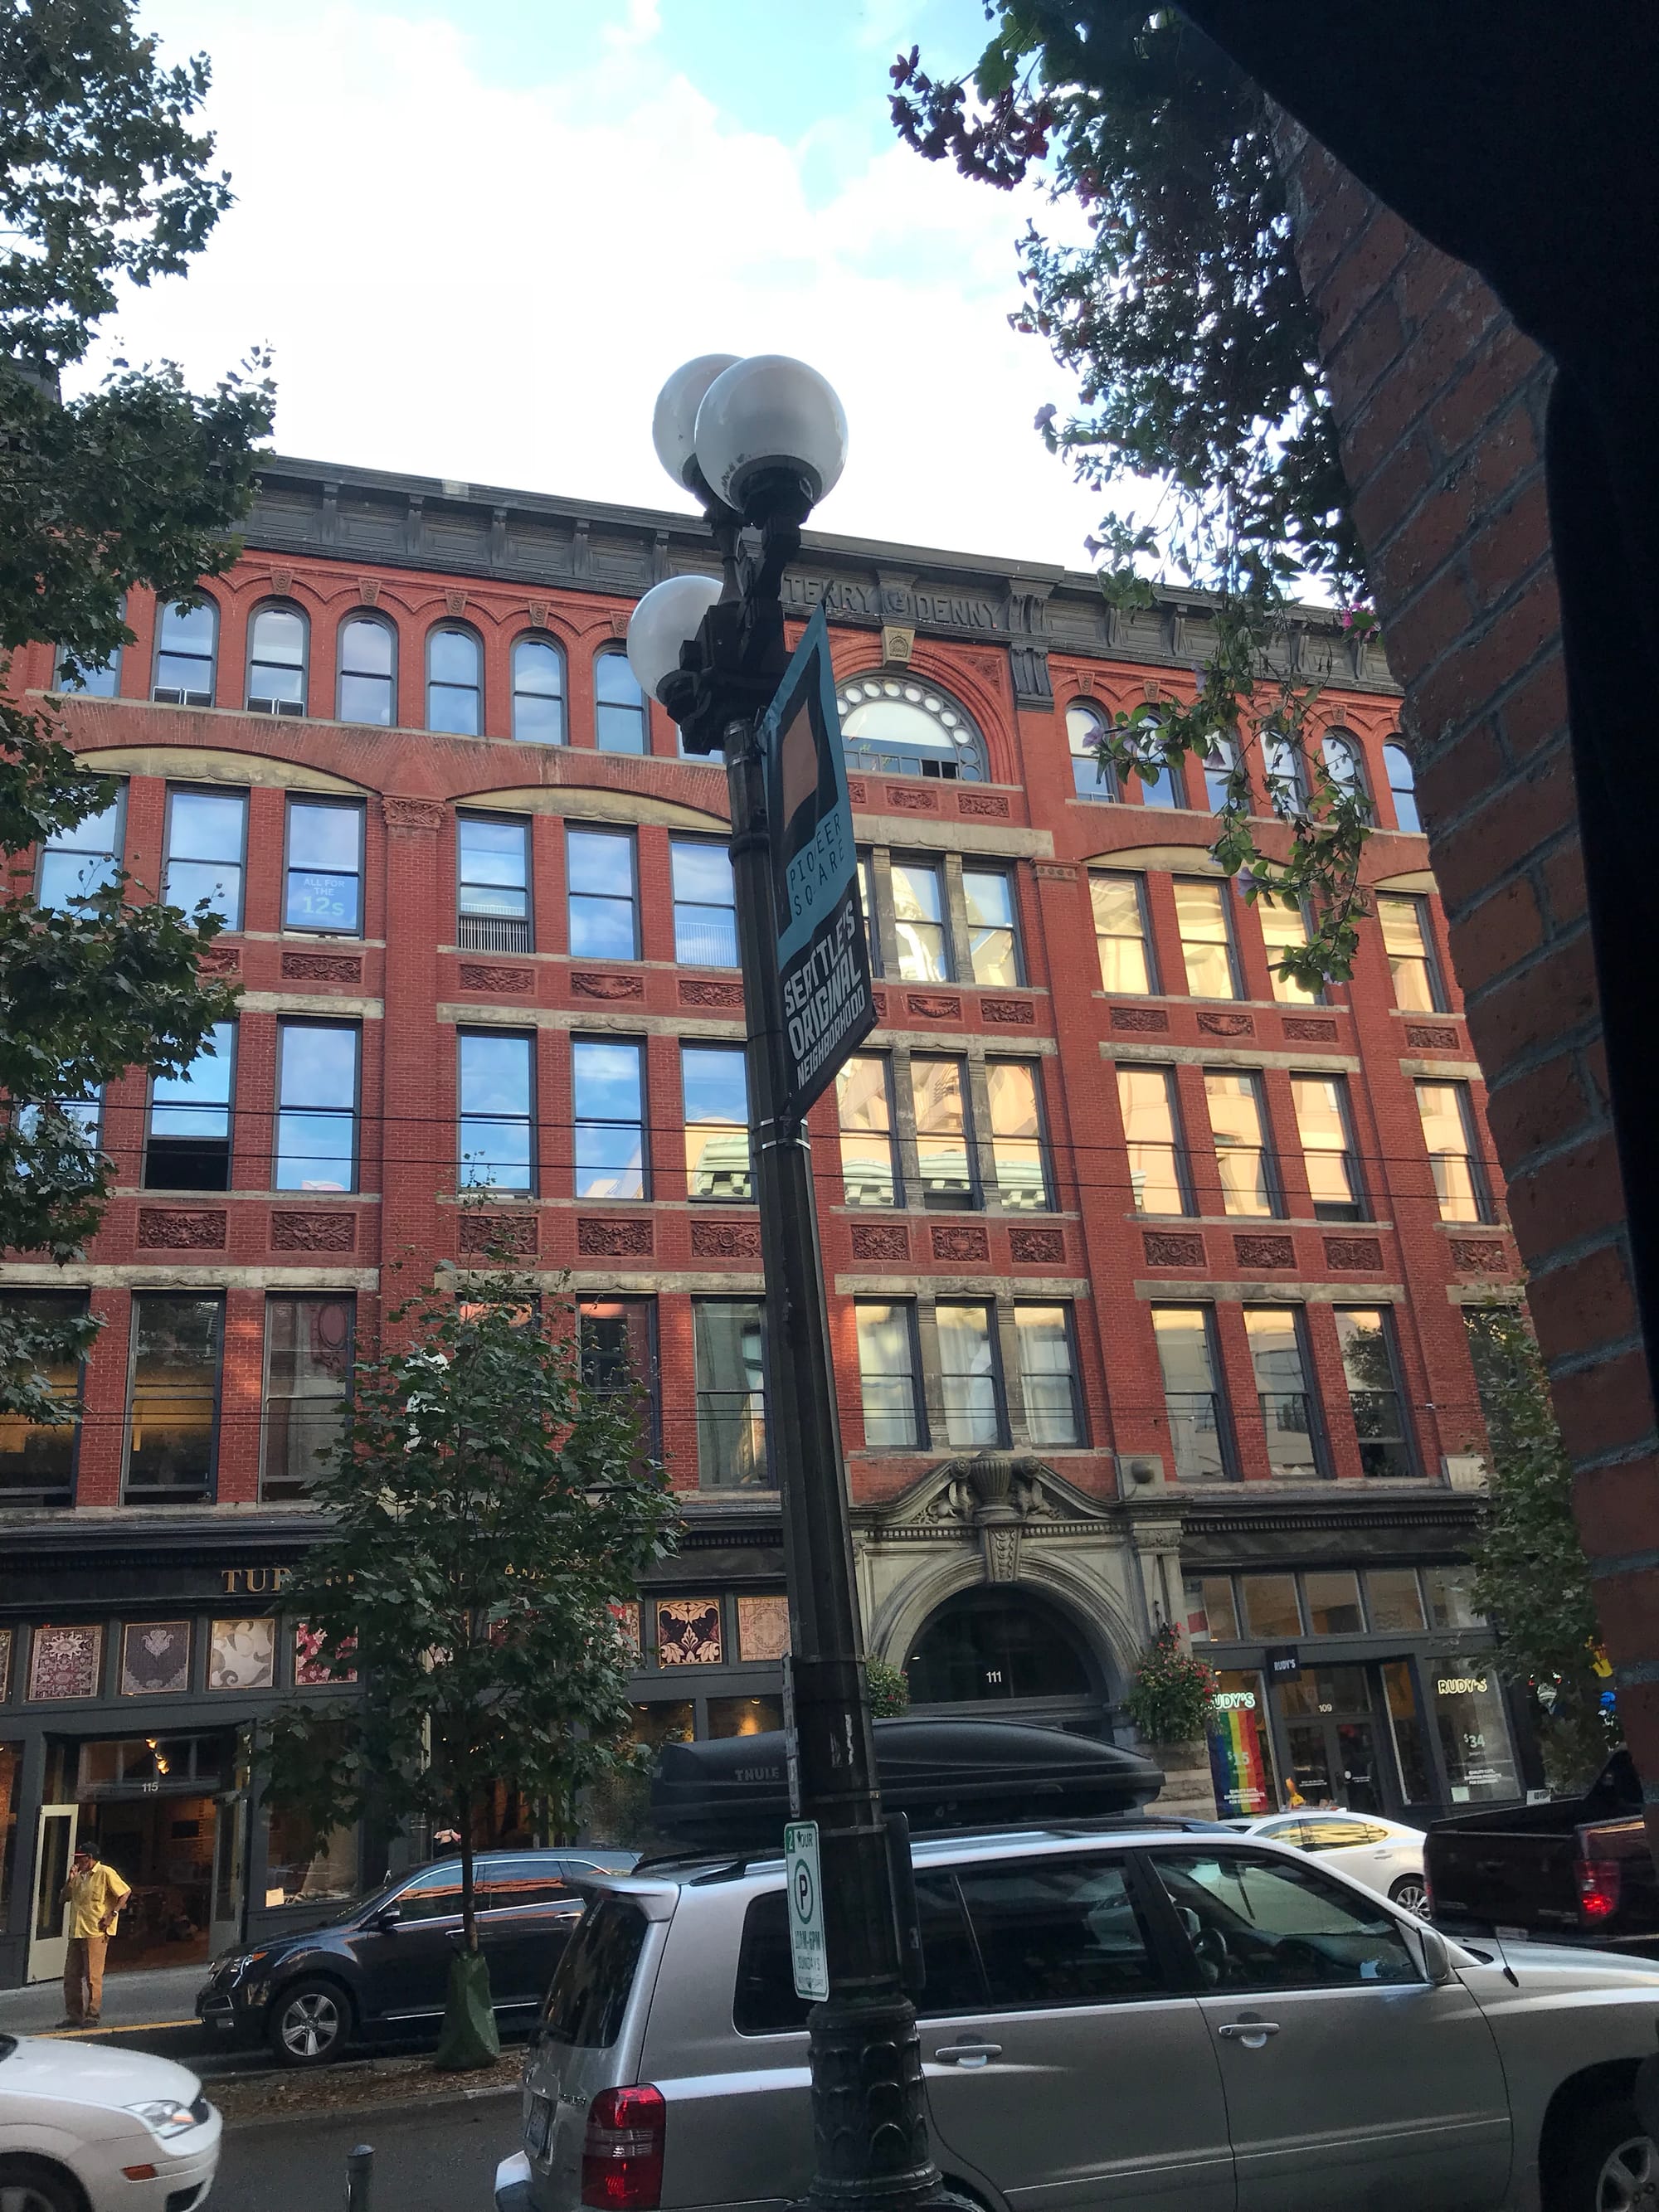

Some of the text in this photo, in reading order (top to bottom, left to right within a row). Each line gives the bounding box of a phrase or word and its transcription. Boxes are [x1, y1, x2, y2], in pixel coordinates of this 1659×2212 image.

[784, 576, 1001, 630] TERRY DENNY
[790, 813, 841, 891] PIOEER
[304, 878, 345, 887] ALL FOR
[794, 839, 844, 916] SQARE
[314, 887, 335, 896] THE
[784, 899, 856, 1018] SEATTLE'S
[789, 945, 861, 1061] ORIGINAL
[796, 984, 865, 1090] NEIGHBORHOOD
[1274, 1659, 1297, 1671] RUDY'S
[985, 1670, 1002, 1683] 111
[1437, 1678, 1487, 1695] RUDY'S
[1210, 1692, 1256, 1709] UDY'S
[1317, 1704, 1333, 1713] 109
[1463, 1733, 1486, 1748] $34
[1227, 1751, 1250, 1766] $15
[734, 1767, 780, 1782] THULE
[141, 1782, 158, 1792] 115
[788, 1830, 794, 1850] 2
[799, 1874, 808, 1910] P
